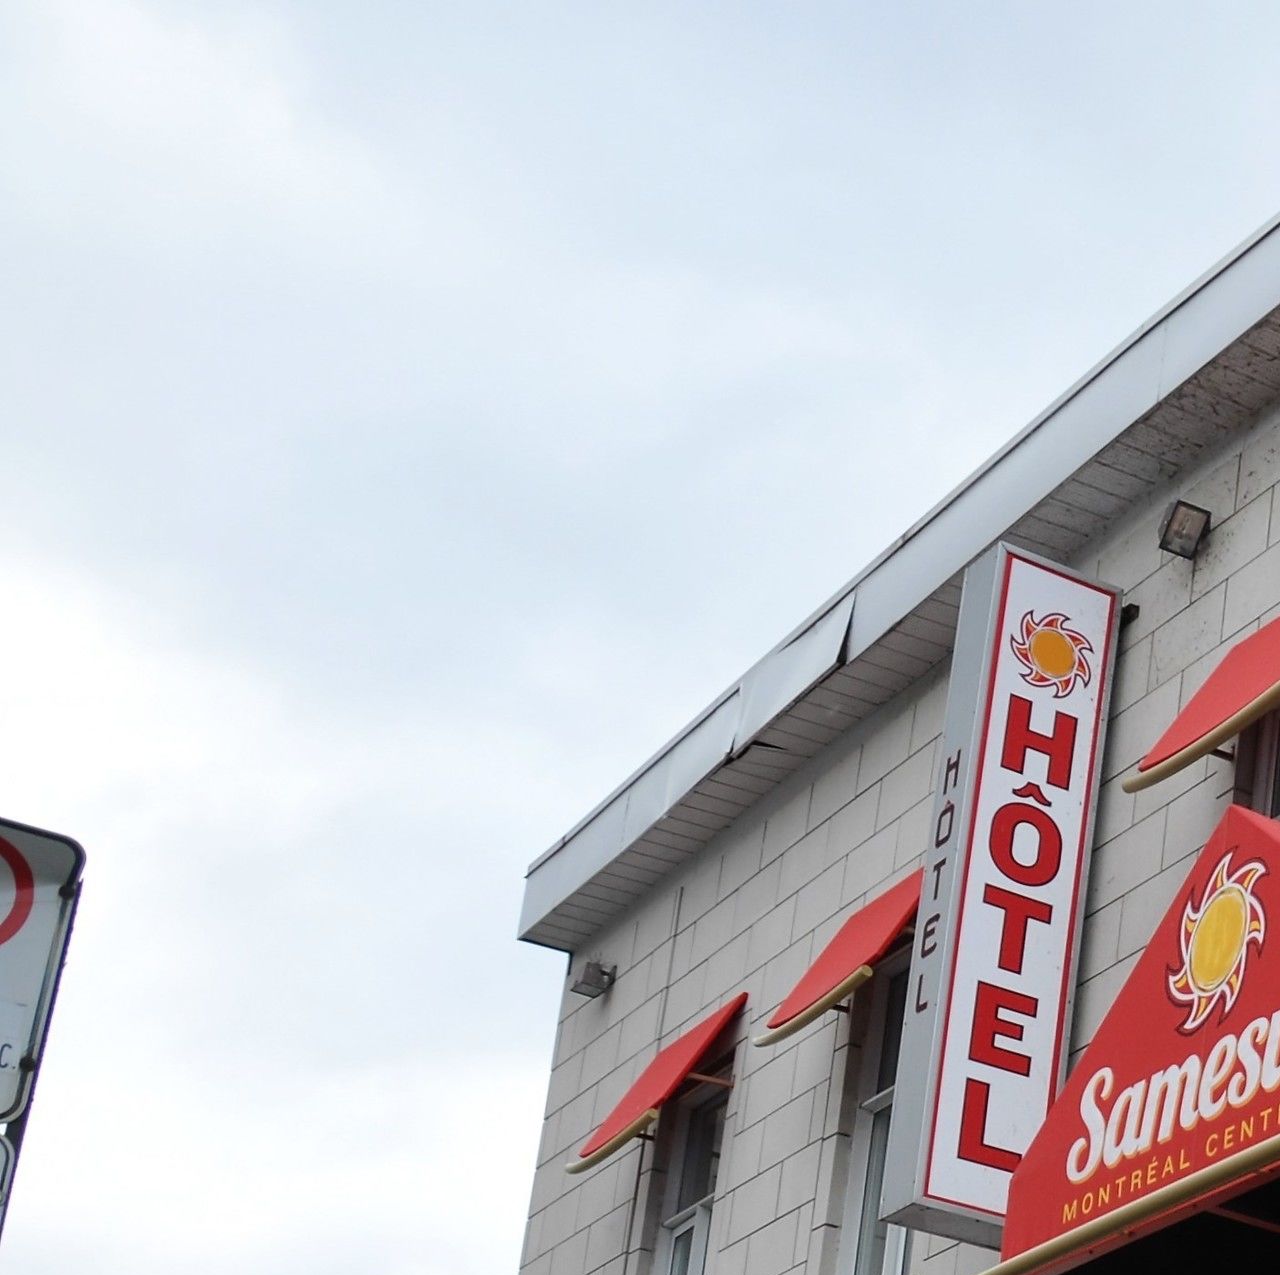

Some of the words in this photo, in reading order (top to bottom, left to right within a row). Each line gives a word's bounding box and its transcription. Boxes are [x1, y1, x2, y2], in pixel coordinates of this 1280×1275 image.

[914, 748, 961, 1014] HÔTEL
[956, 693, 1079, 1173] HÔTEL
[1061, 1149, 1191, 1225] MONTRÉAL
